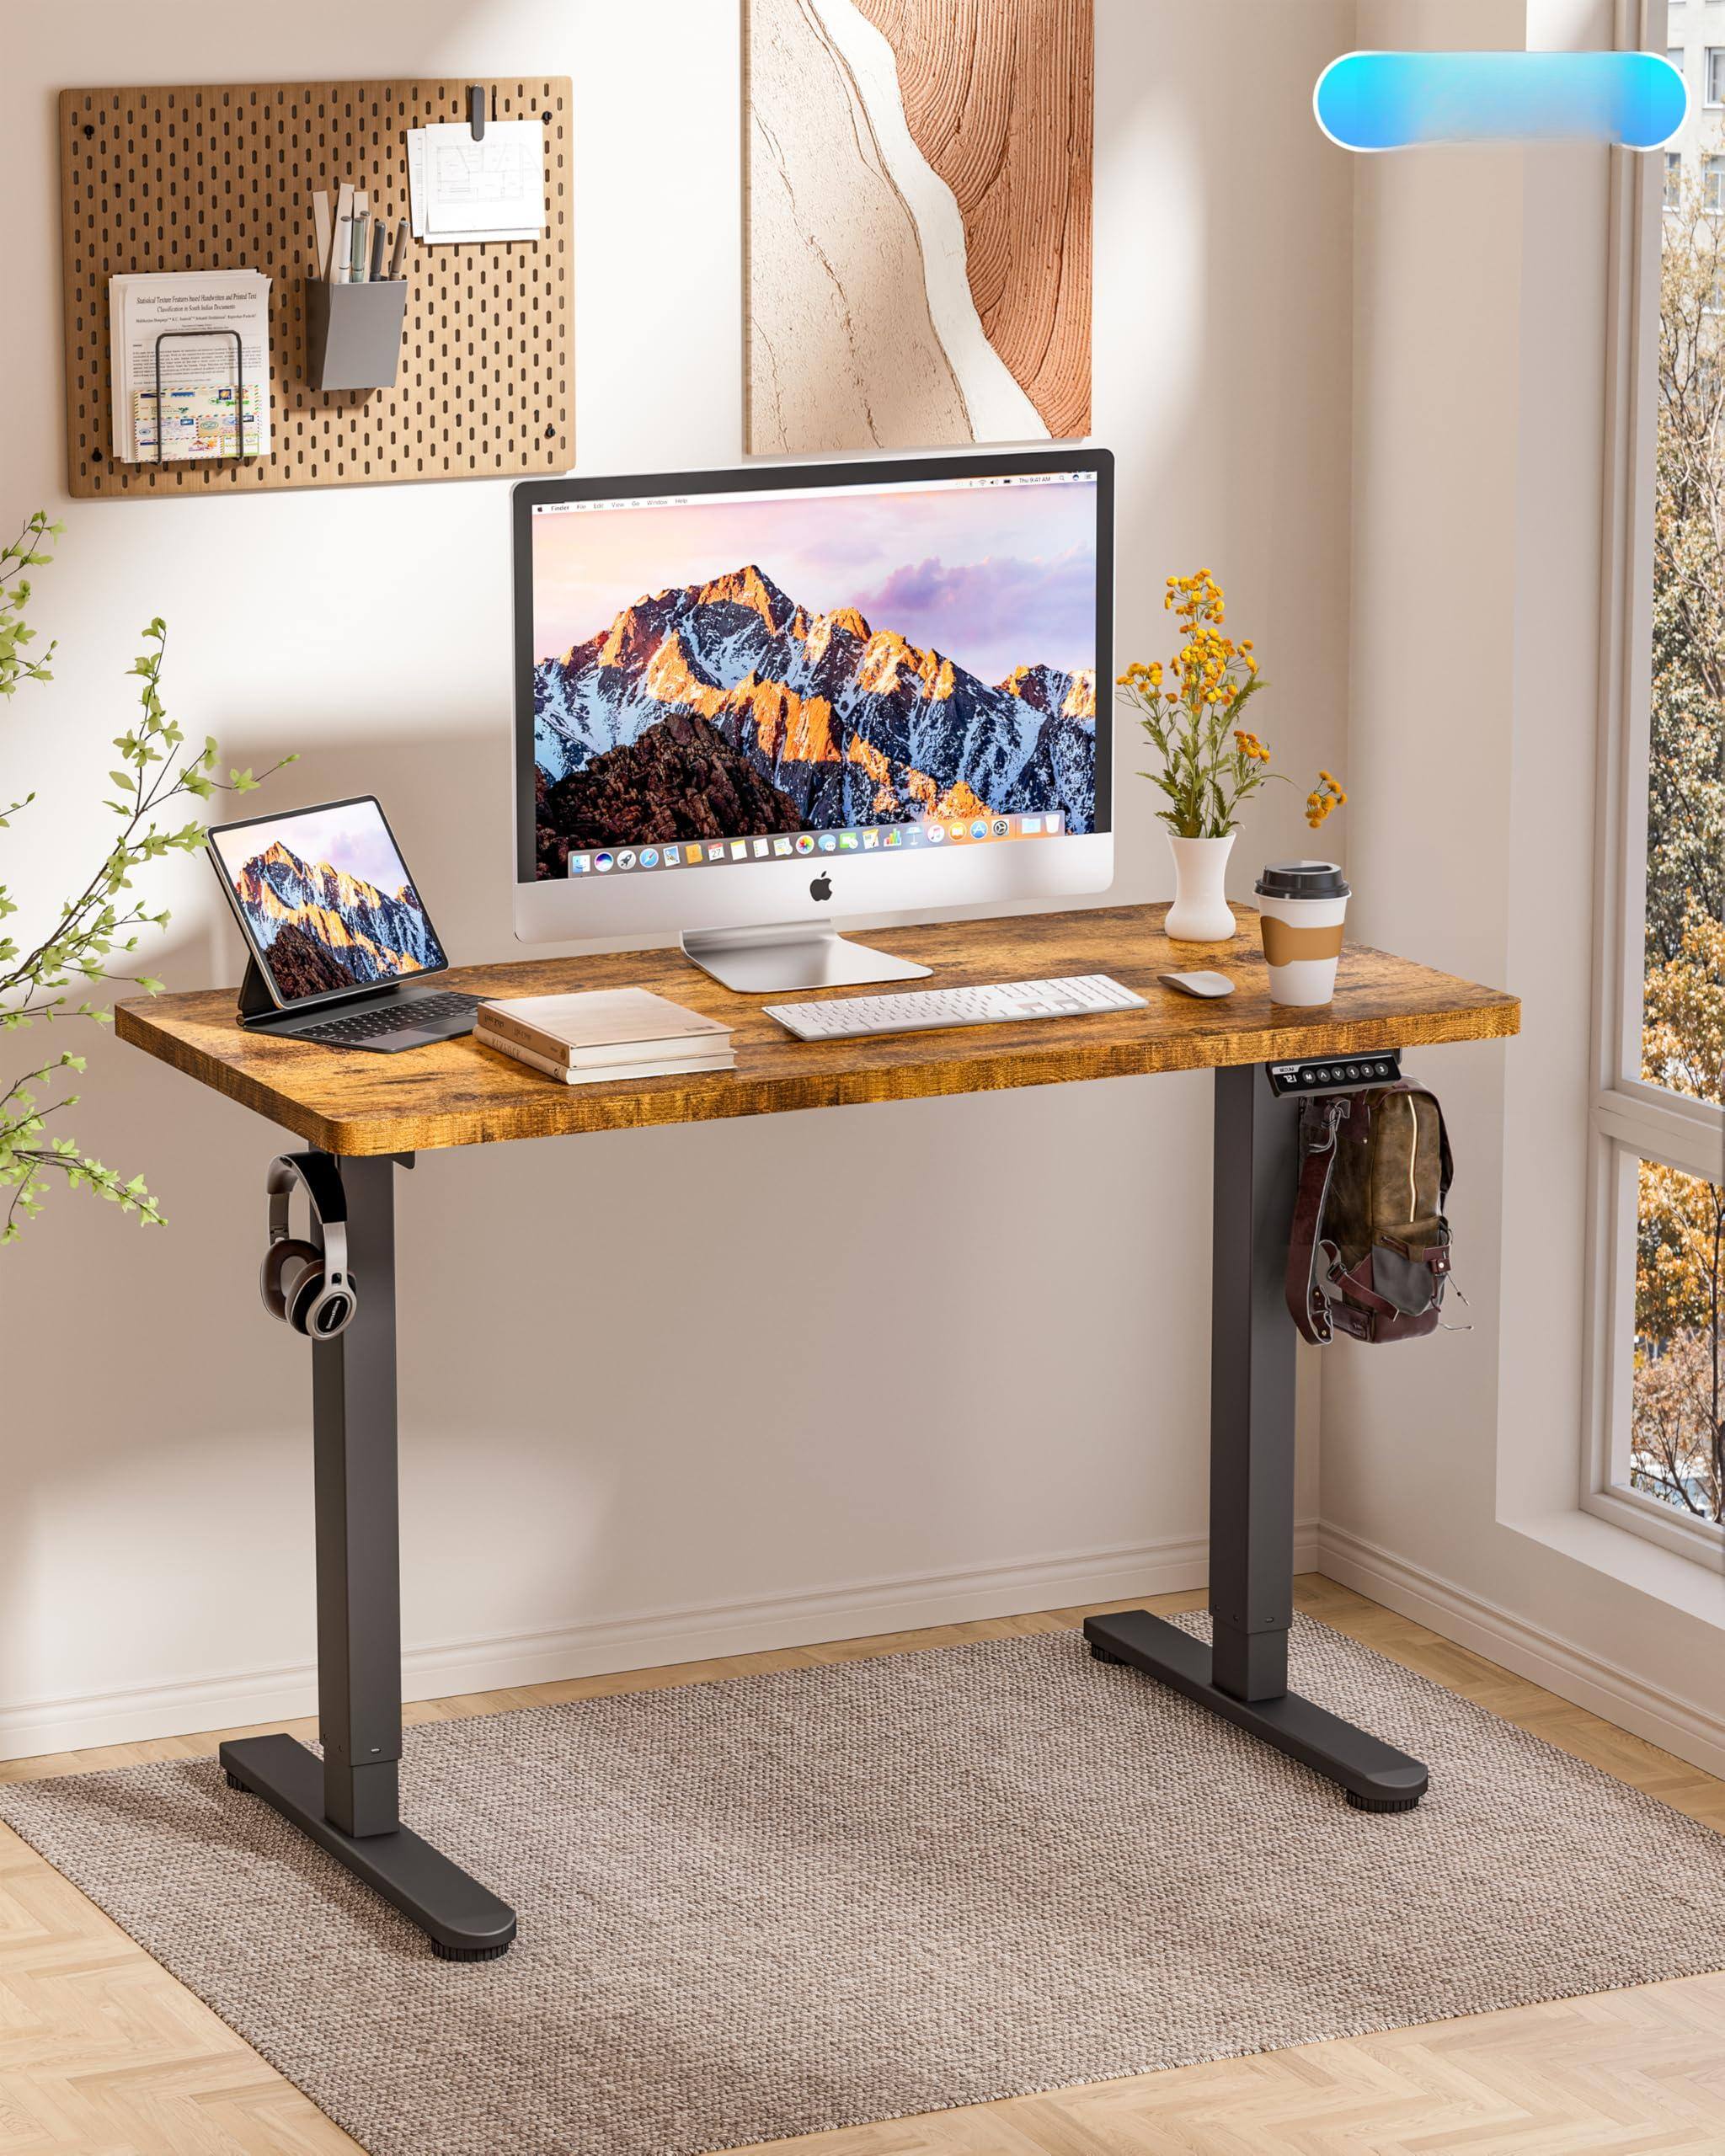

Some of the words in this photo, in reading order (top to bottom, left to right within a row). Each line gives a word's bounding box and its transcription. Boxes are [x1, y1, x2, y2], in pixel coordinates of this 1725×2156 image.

[157, 296, 171, 304] Texture
[172, 295, 188, 303] Features
[201, 294, 225, 302] Handwritten
[248, 292, 257, 301] Text
[712, 849, 721, 857] 27
